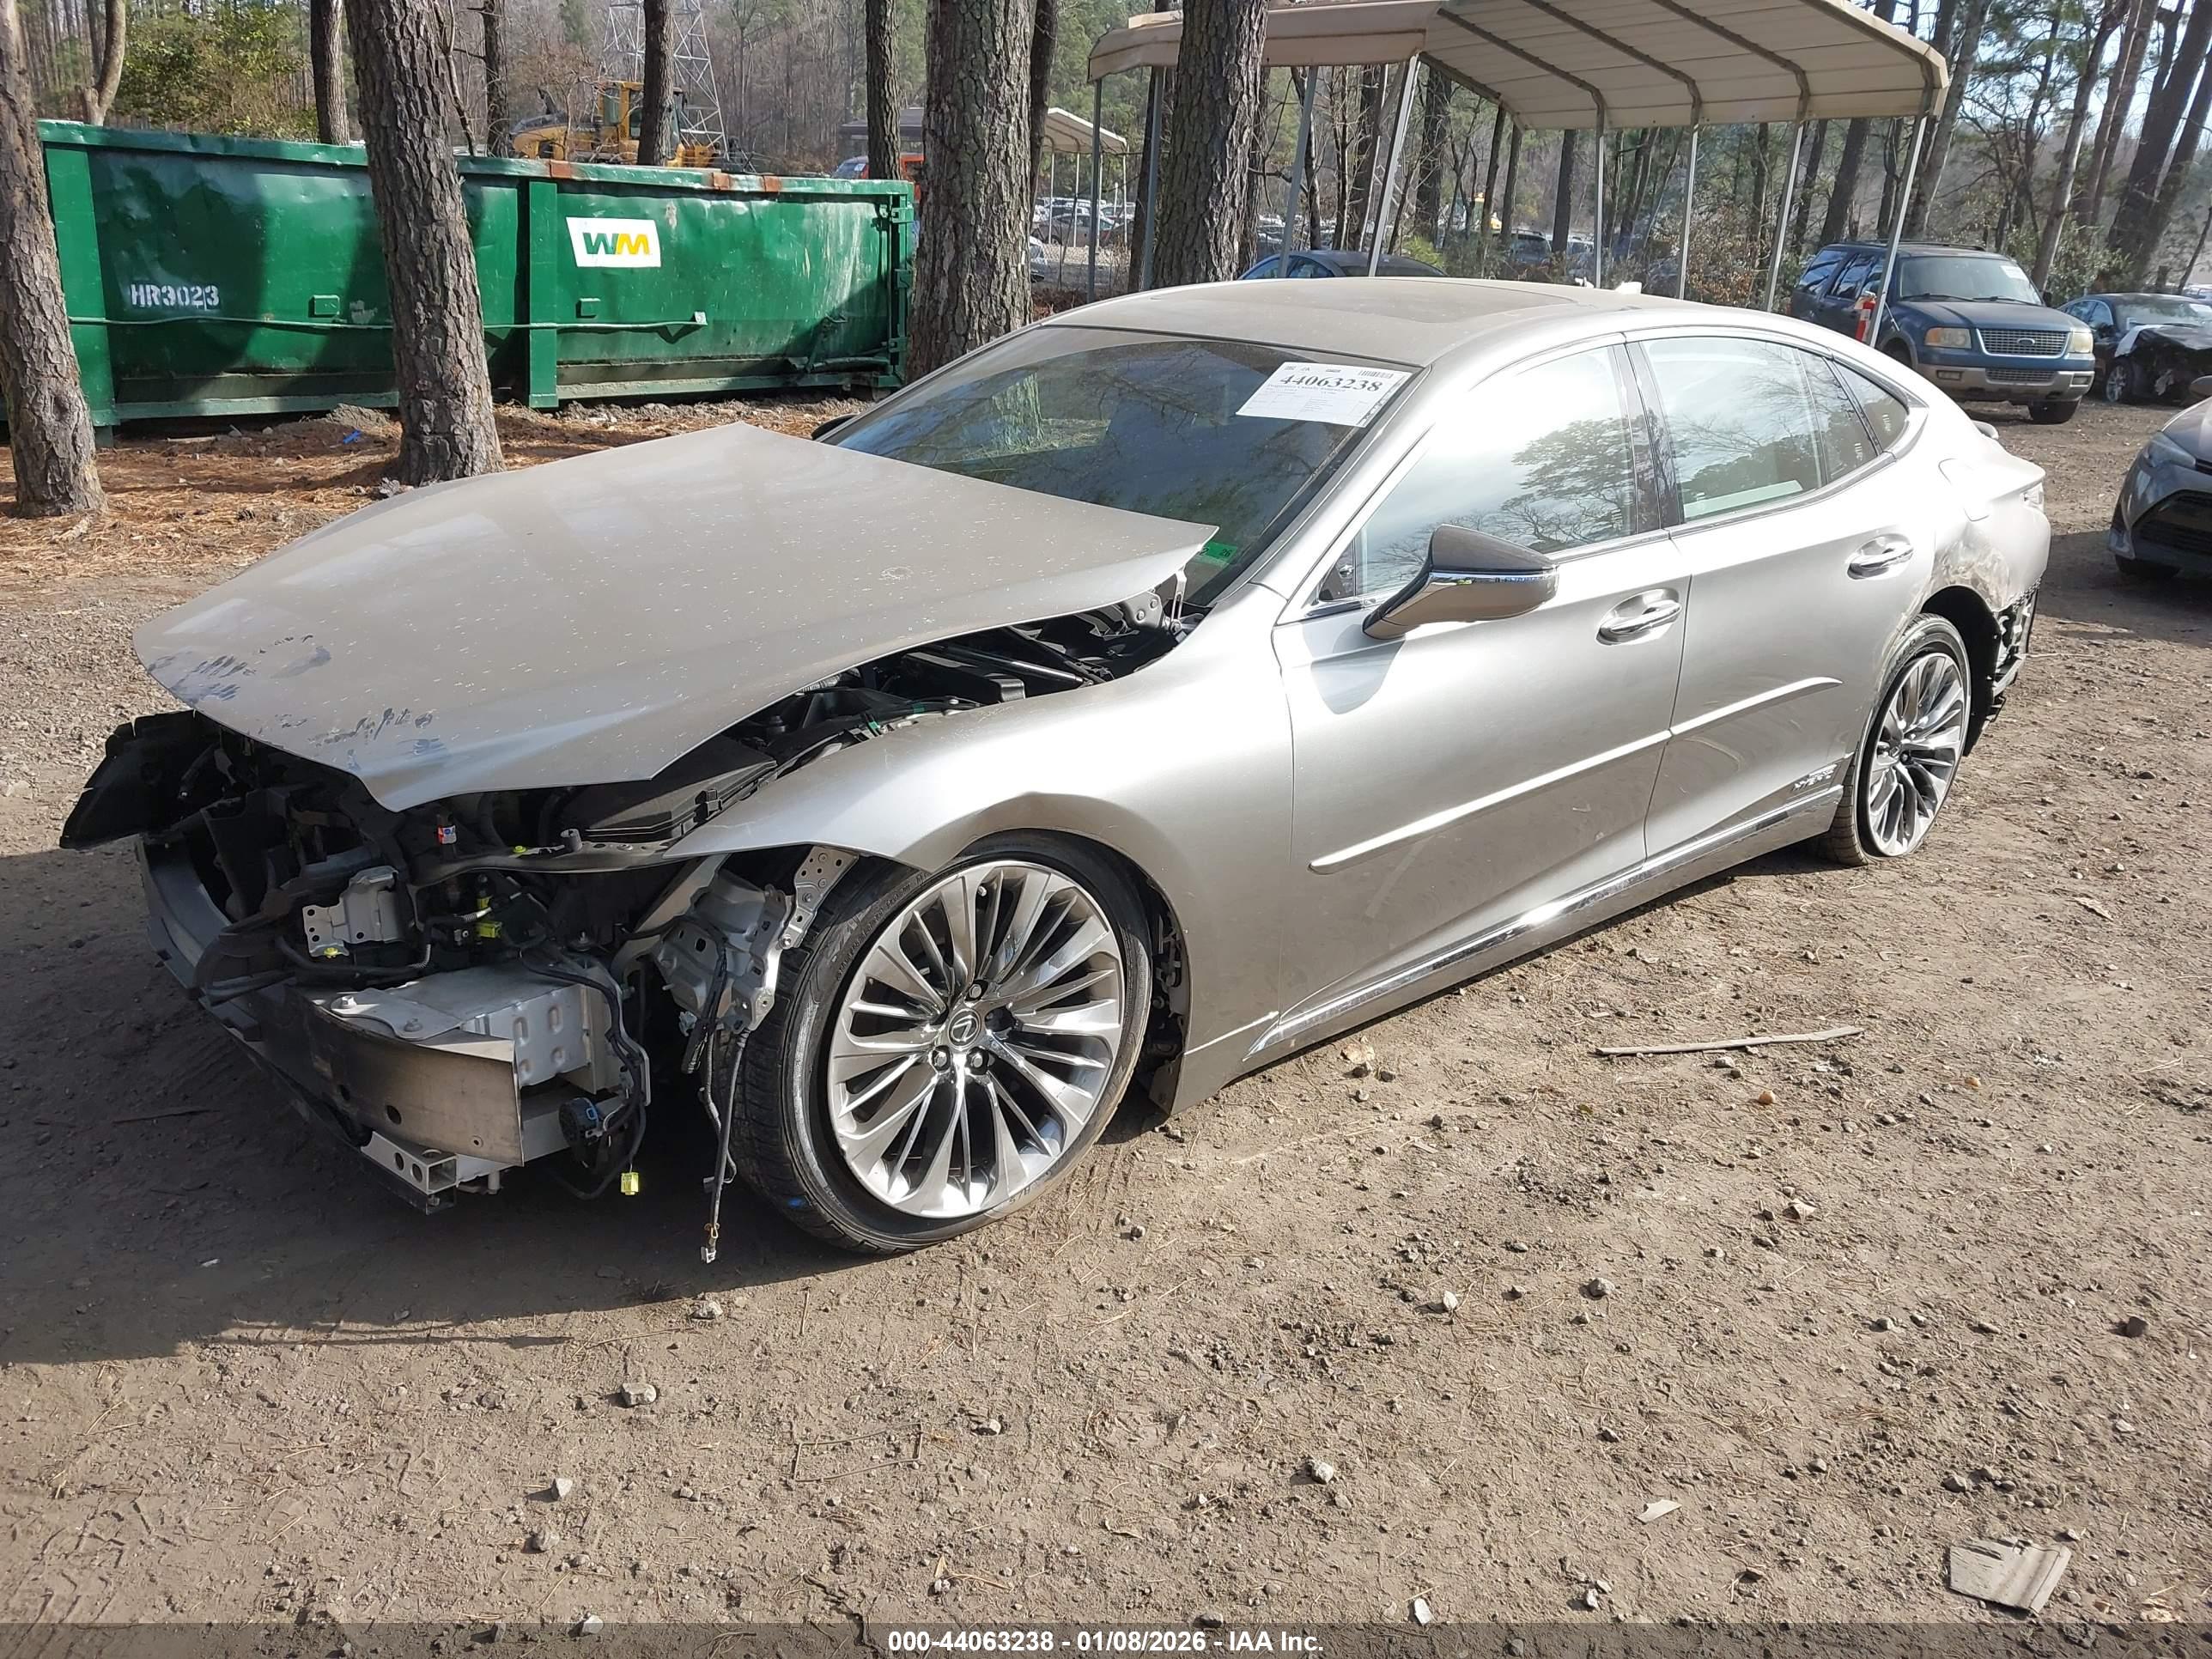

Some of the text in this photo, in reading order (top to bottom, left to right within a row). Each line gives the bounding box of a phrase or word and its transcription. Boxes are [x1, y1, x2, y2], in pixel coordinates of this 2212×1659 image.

[582, 232, 650, 255] WM
[130, 283, 220, 307] HR3023
[1279, 374, 1383, 392] 44063238
